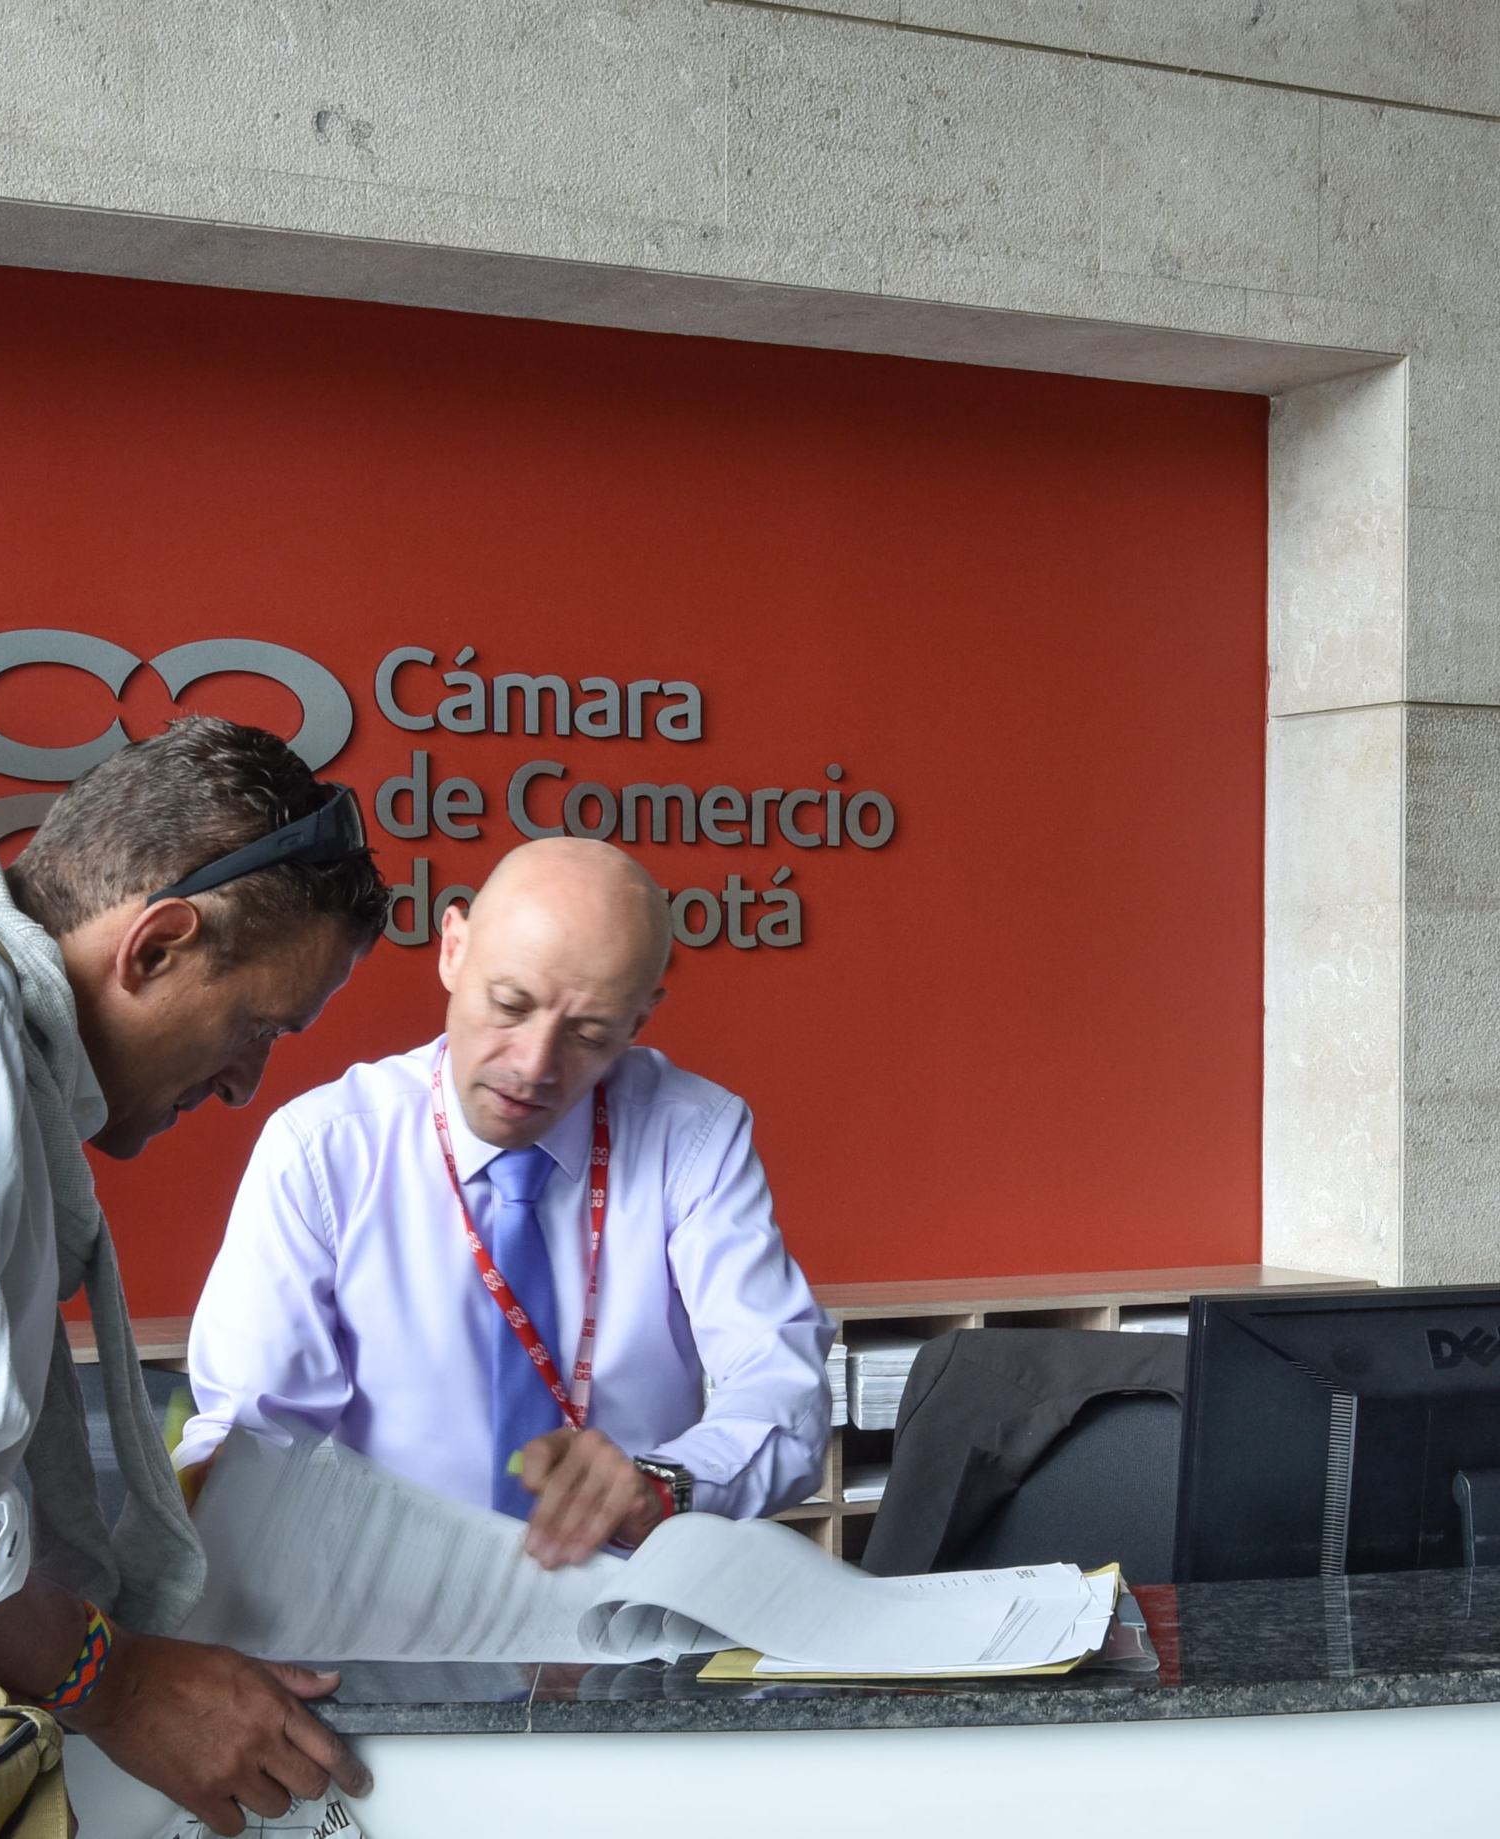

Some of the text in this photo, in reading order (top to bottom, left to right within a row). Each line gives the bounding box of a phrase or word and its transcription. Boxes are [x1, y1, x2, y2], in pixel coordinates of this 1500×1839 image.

[374, 646, 703, 742] Cámara
[376, 750, 896, 849] de Comercio
[1425, 1325, 1500, 1369] DE
